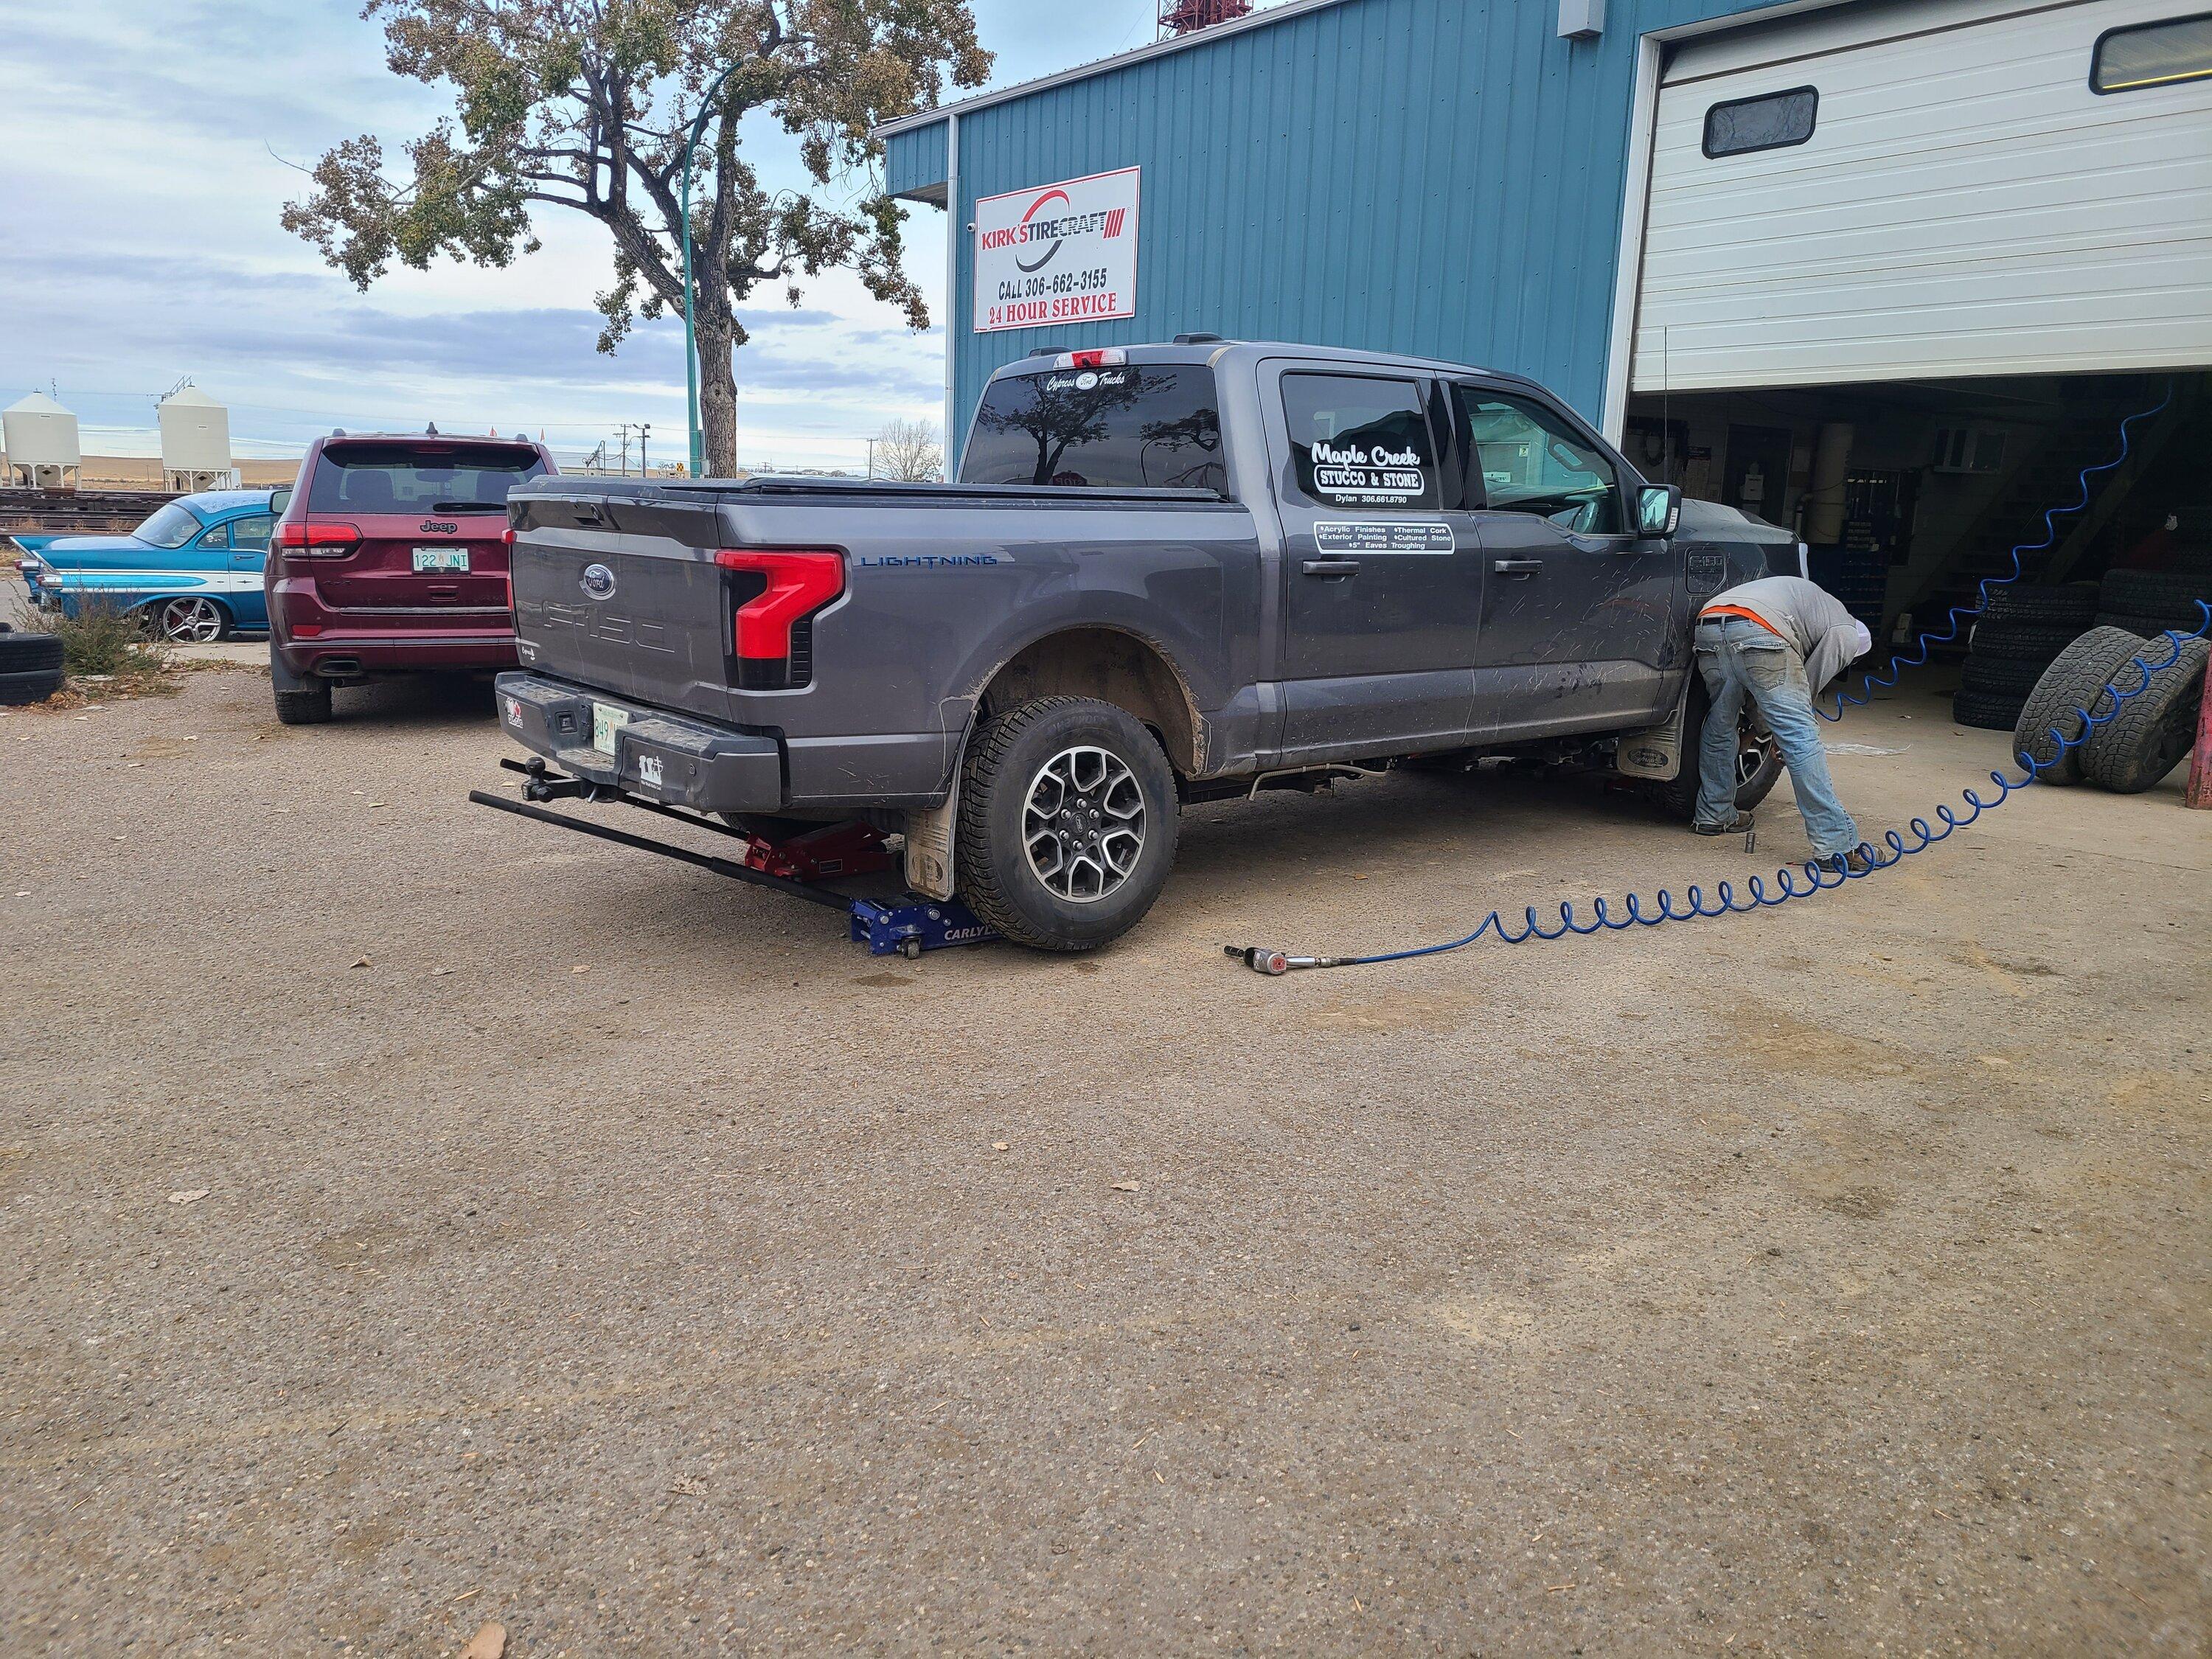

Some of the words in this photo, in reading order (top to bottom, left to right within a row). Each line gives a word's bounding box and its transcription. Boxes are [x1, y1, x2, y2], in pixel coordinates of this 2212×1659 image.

[998, 279, 1022, 301] CALL
[1025, 268, 1107, 297] 306-662-3155
[989, 305, 1002, 324] 24
[1006, 301, 1048, 322] HOUR
[1051, 292, 1116, 318] SERVICE
[1047, 375, 1075, 392] Cypress
[1099, 372, 1125, 386] Trucks
[1311, 442, 1368, 472] Maple
[1371, 445, 1421, 467] Creek
[1320, 470, 1366, 486] STUCCO
[1371, 472, 1380, 487] &
[1382, 473, 1419, 488] STONE
[1335, 495, 1357, 504] Dylan
[1362, 495, 1408, 504] 306.661.8790
[420, 520, 458, 534] Jeep
[1357, 534, 1388, 542] Painting
[415, 554, 437, 567] 122
[446, 554, 467, 567] JNI
[860, 554, 998, 570] LIGHTNING
[588, 570, 606, 590] Ford
[594, 718, 609, 742] 849
[944, 924, 998, 941] CARLYL
